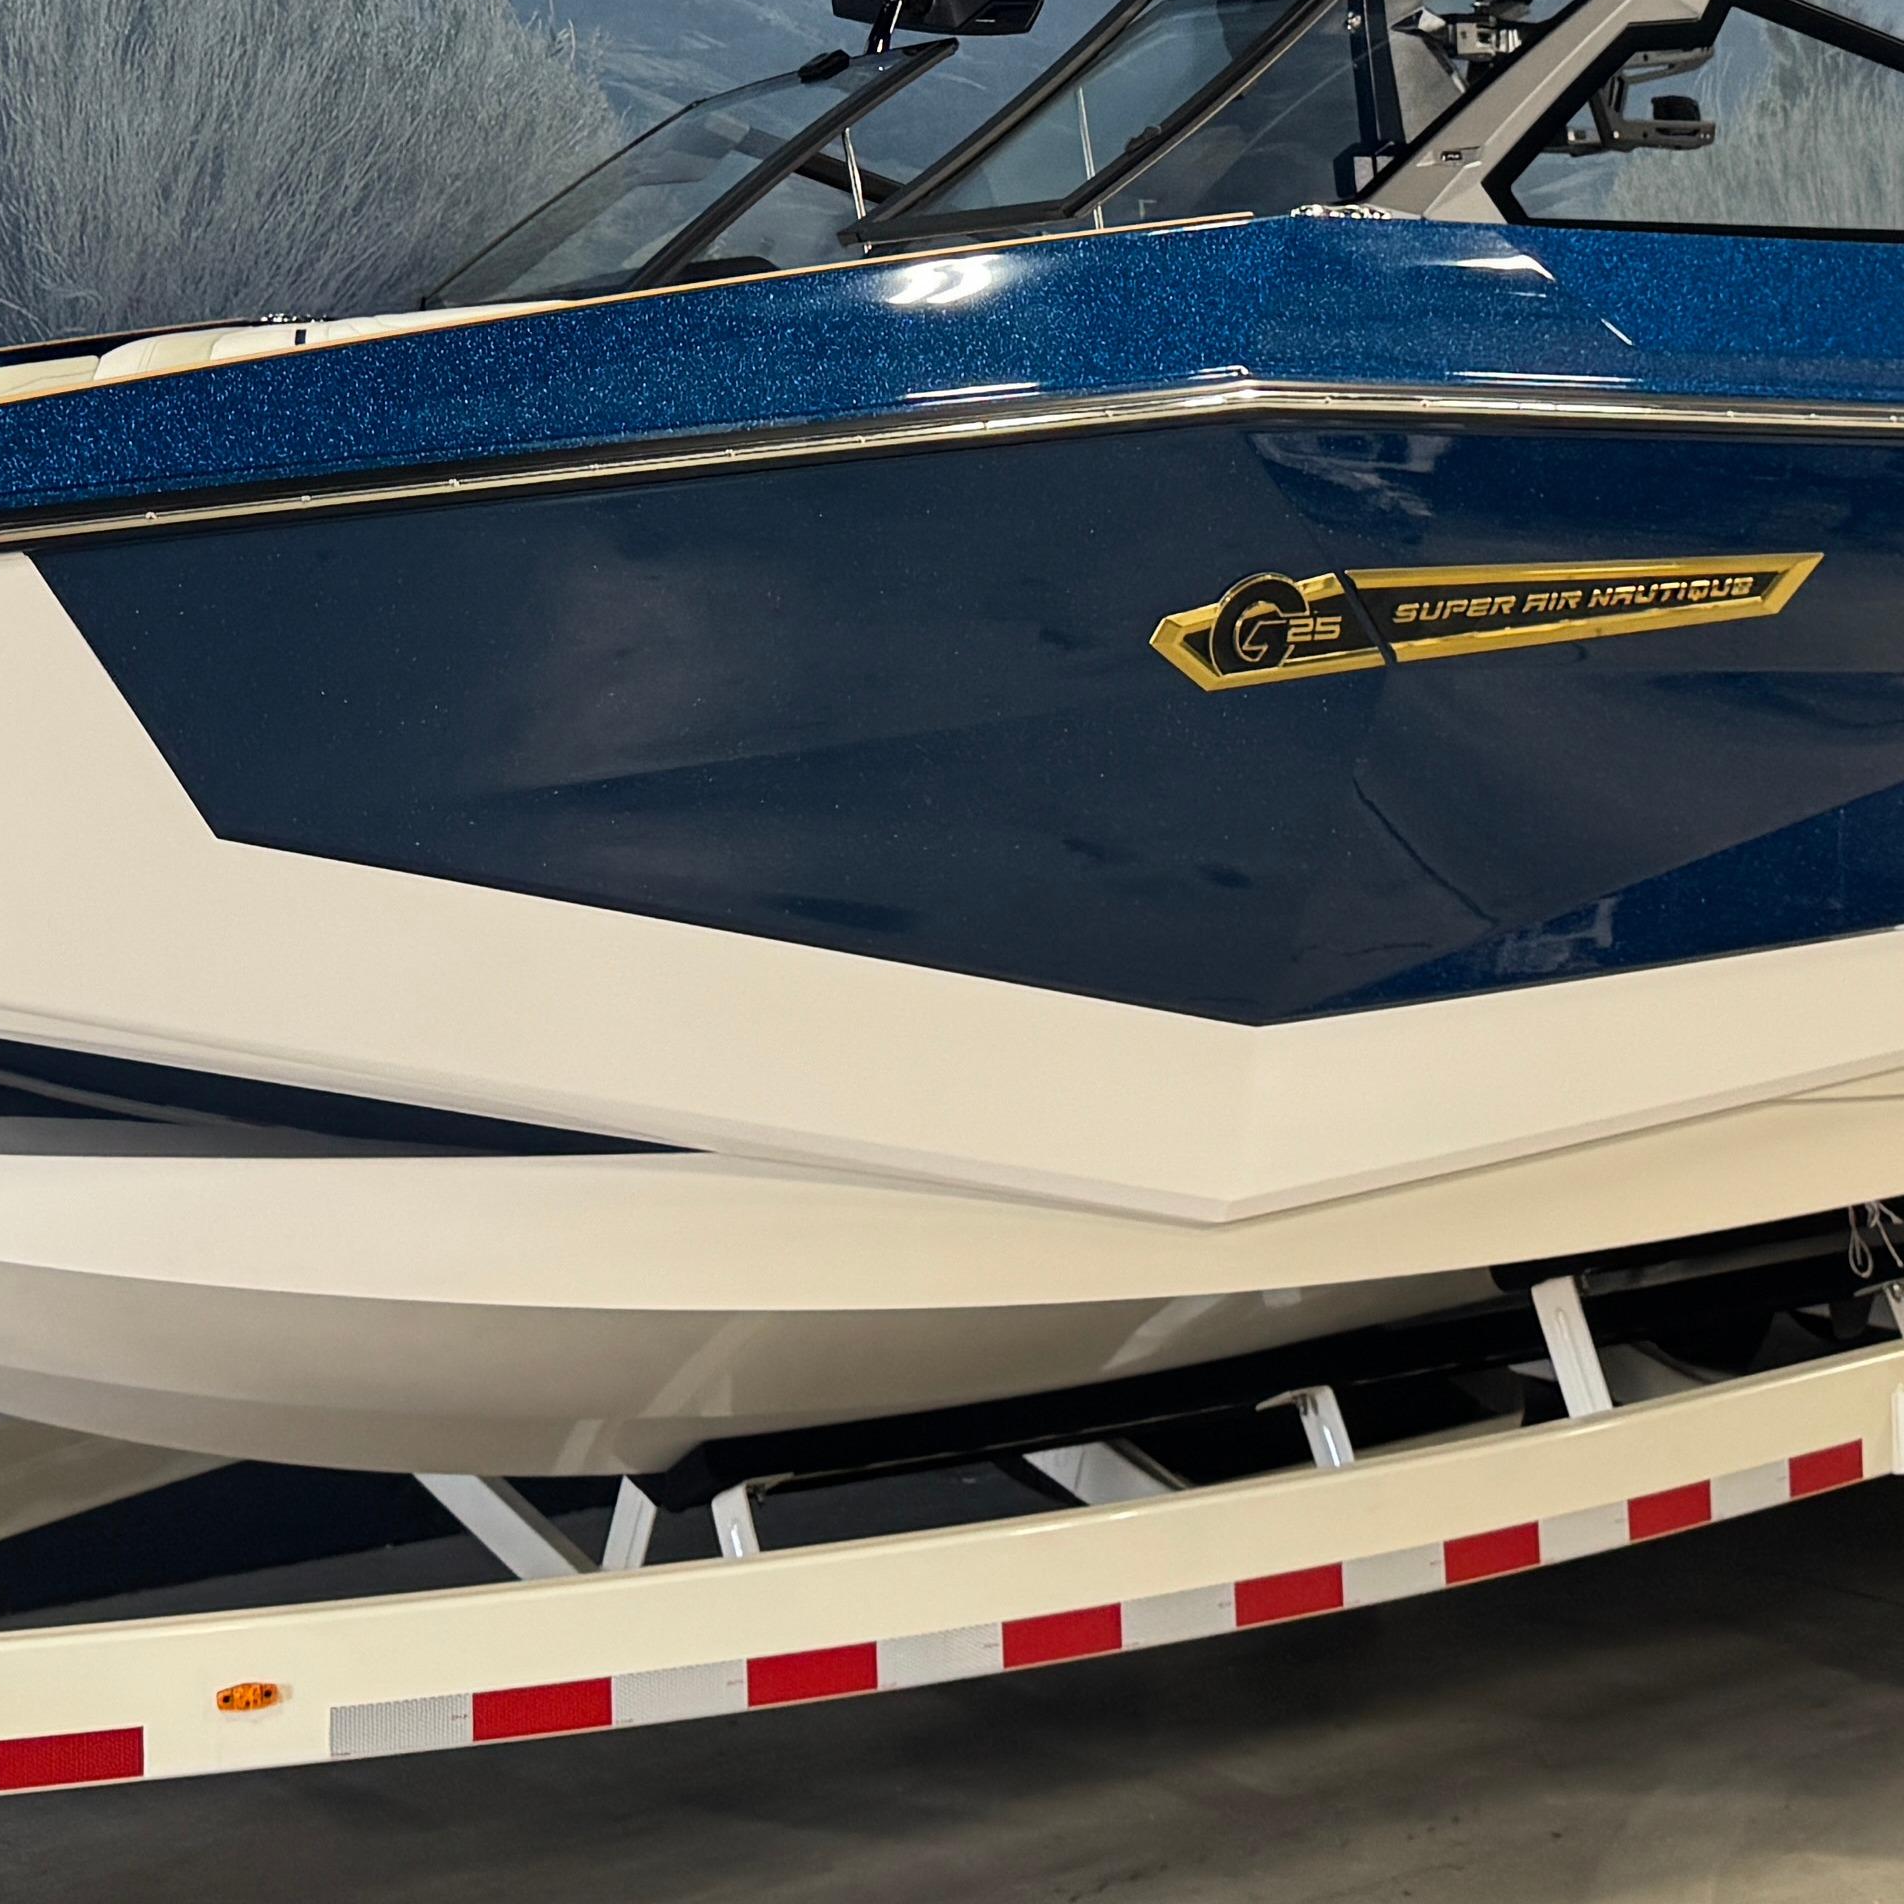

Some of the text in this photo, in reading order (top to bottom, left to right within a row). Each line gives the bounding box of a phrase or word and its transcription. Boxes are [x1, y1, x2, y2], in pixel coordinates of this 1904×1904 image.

[1391, 594, 1517, 624] SUPER
[1522, 589, 1583, 614] AIR
[1587, 576, 1755, 609] NAUTIQUE
